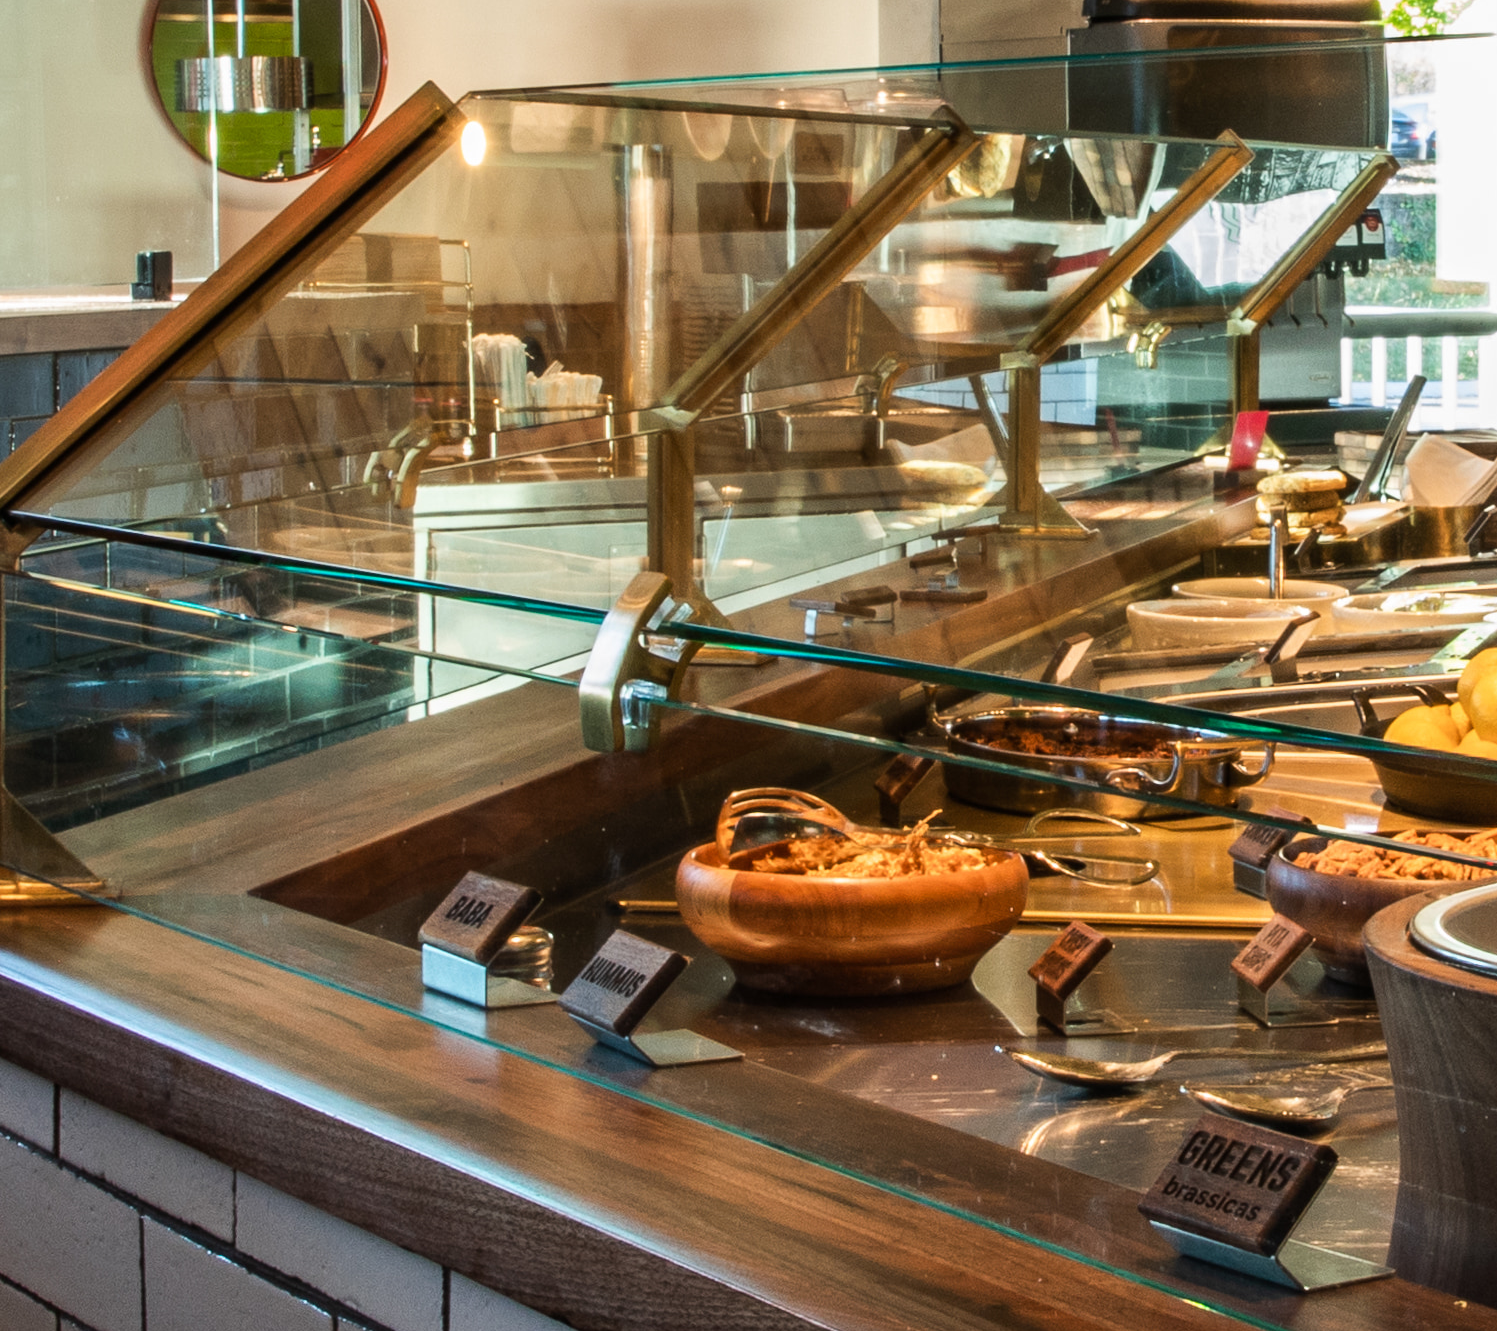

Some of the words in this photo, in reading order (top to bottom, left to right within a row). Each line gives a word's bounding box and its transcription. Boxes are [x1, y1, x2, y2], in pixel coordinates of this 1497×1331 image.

[445, 895, 494, 929] BABA
[581, 955, 647, 998] HUMMUS
[1177, 1130, 1301, 1193] GREENS
[1161, 1175, 1261, 1223] brassicas
